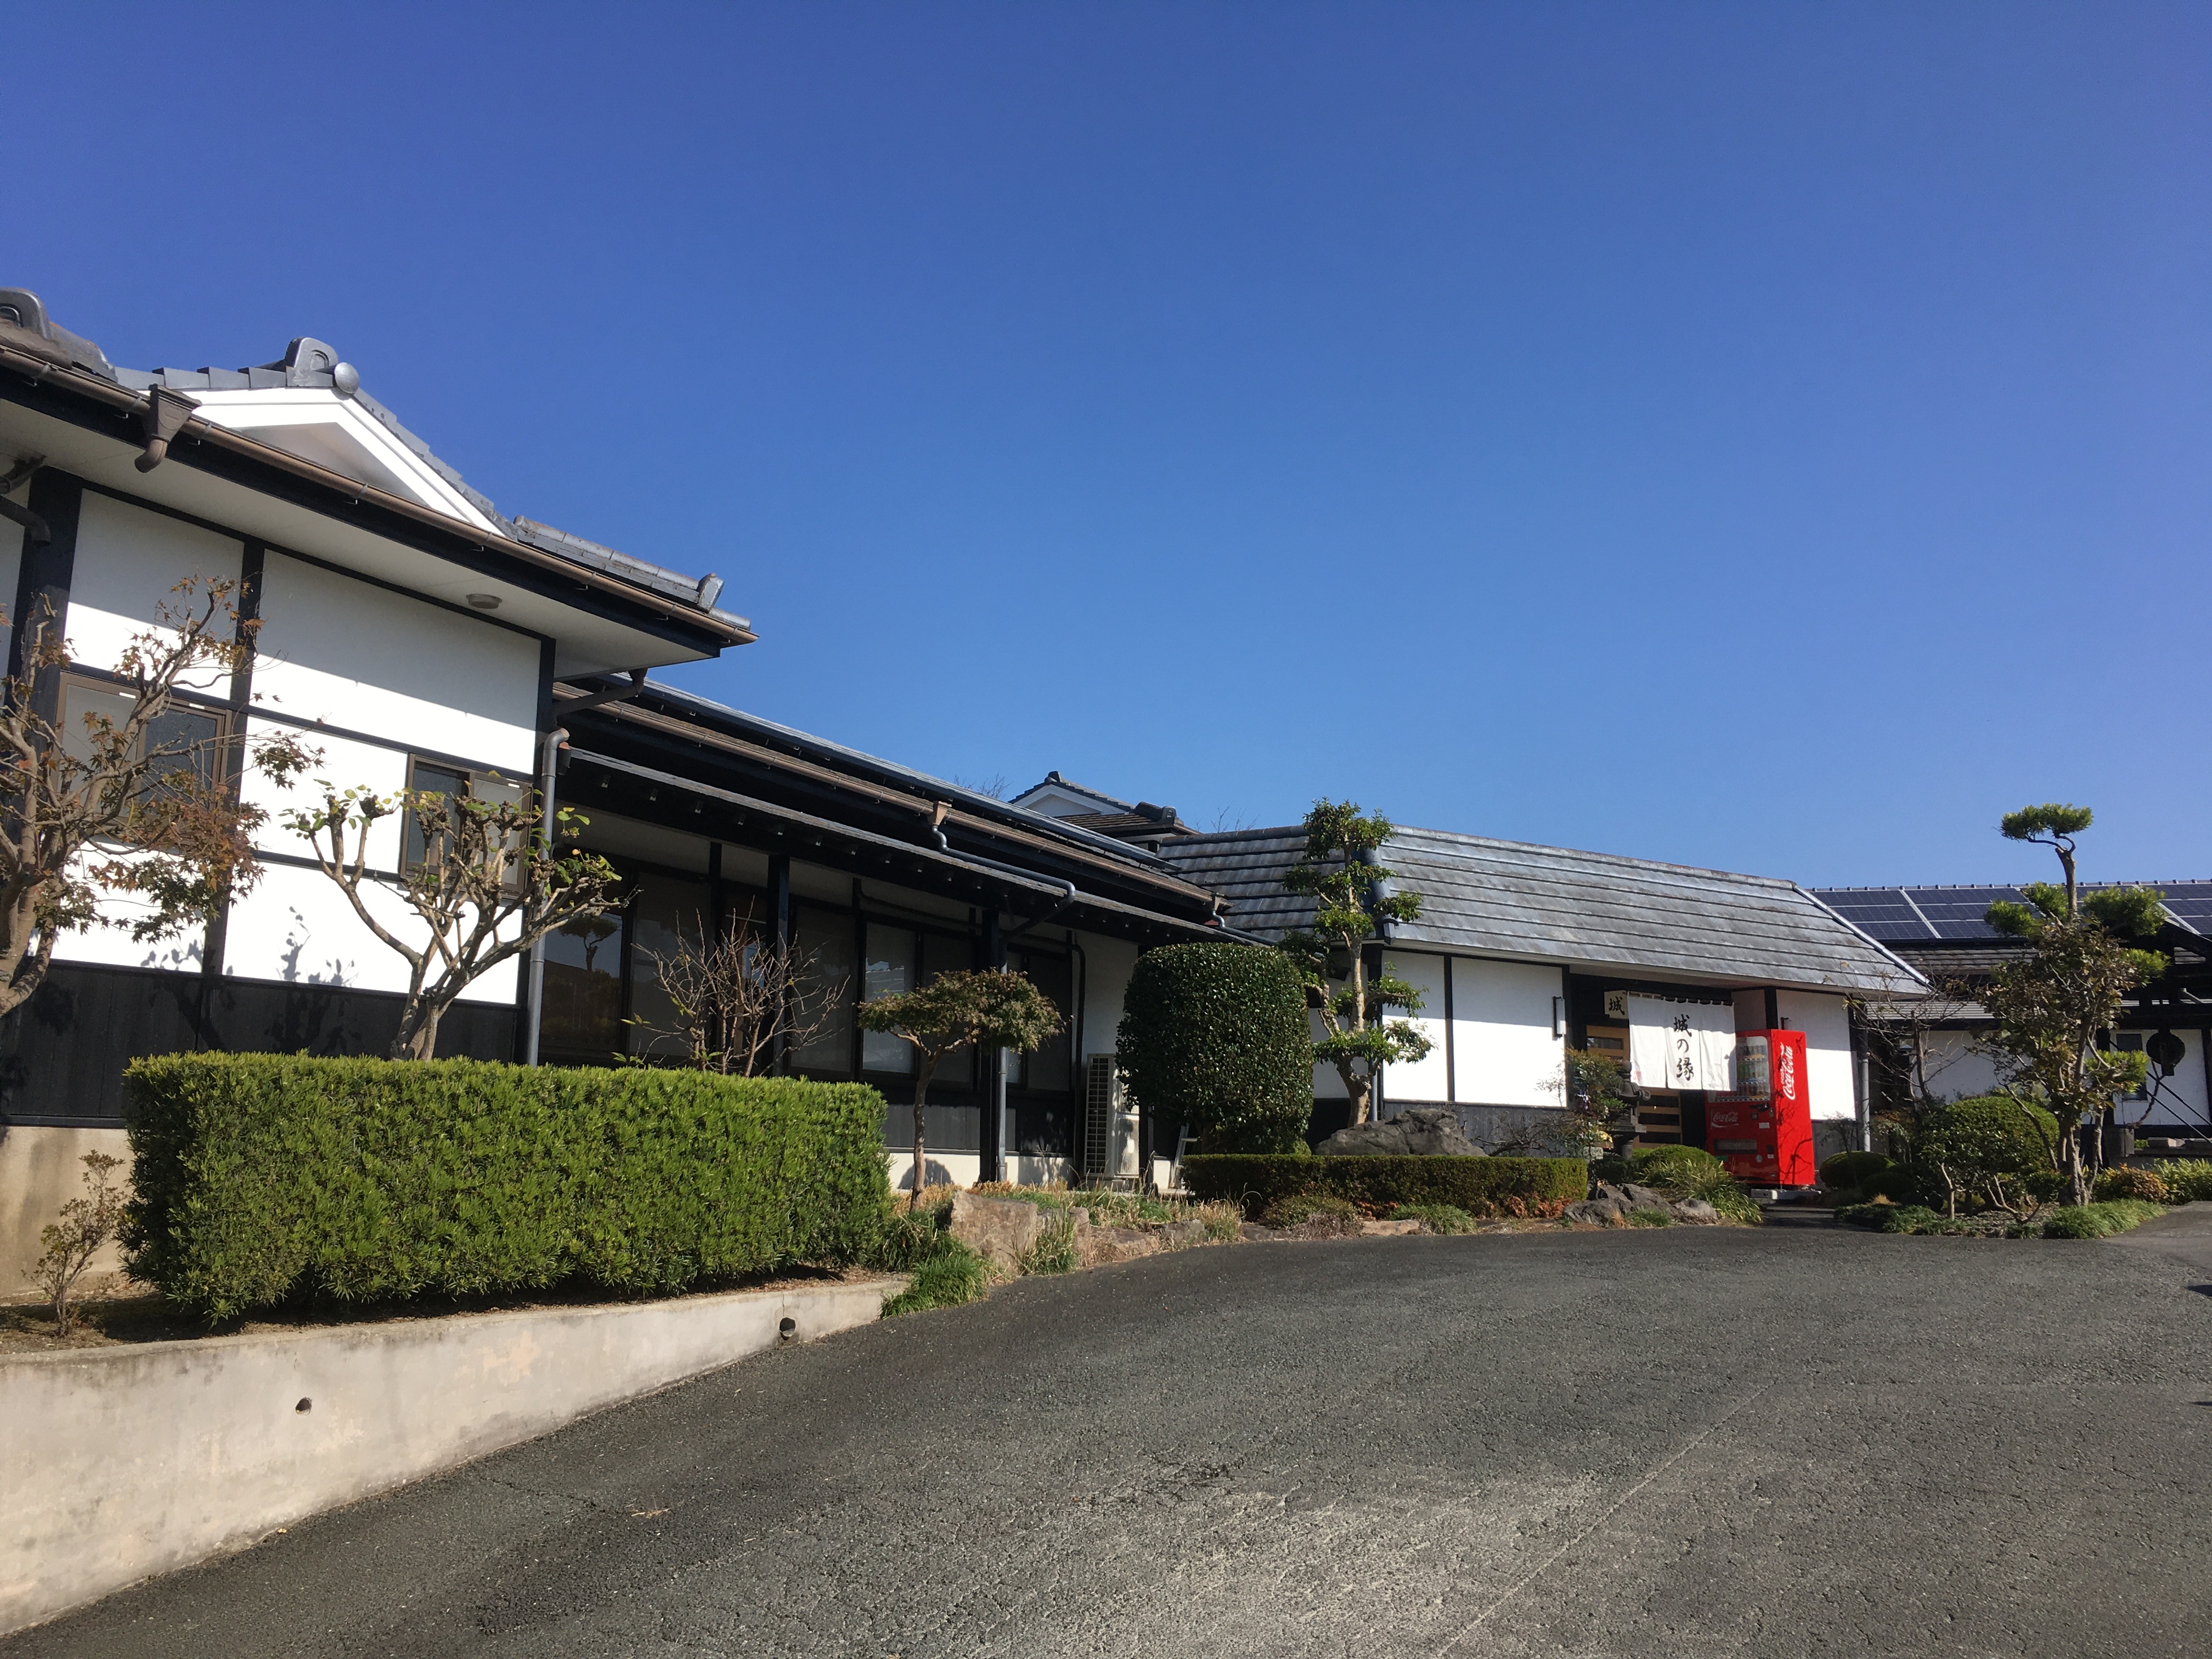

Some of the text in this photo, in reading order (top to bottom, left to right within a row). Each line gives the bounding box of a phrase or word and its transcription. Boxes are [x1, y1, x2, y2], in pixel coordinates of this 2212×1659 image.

[1609, 996, 1625, 1015] 城
[1780, 1042, 1796, 1100] Coca-Cola
[1713, 1111, 1738, 1122] Coca-Cola
